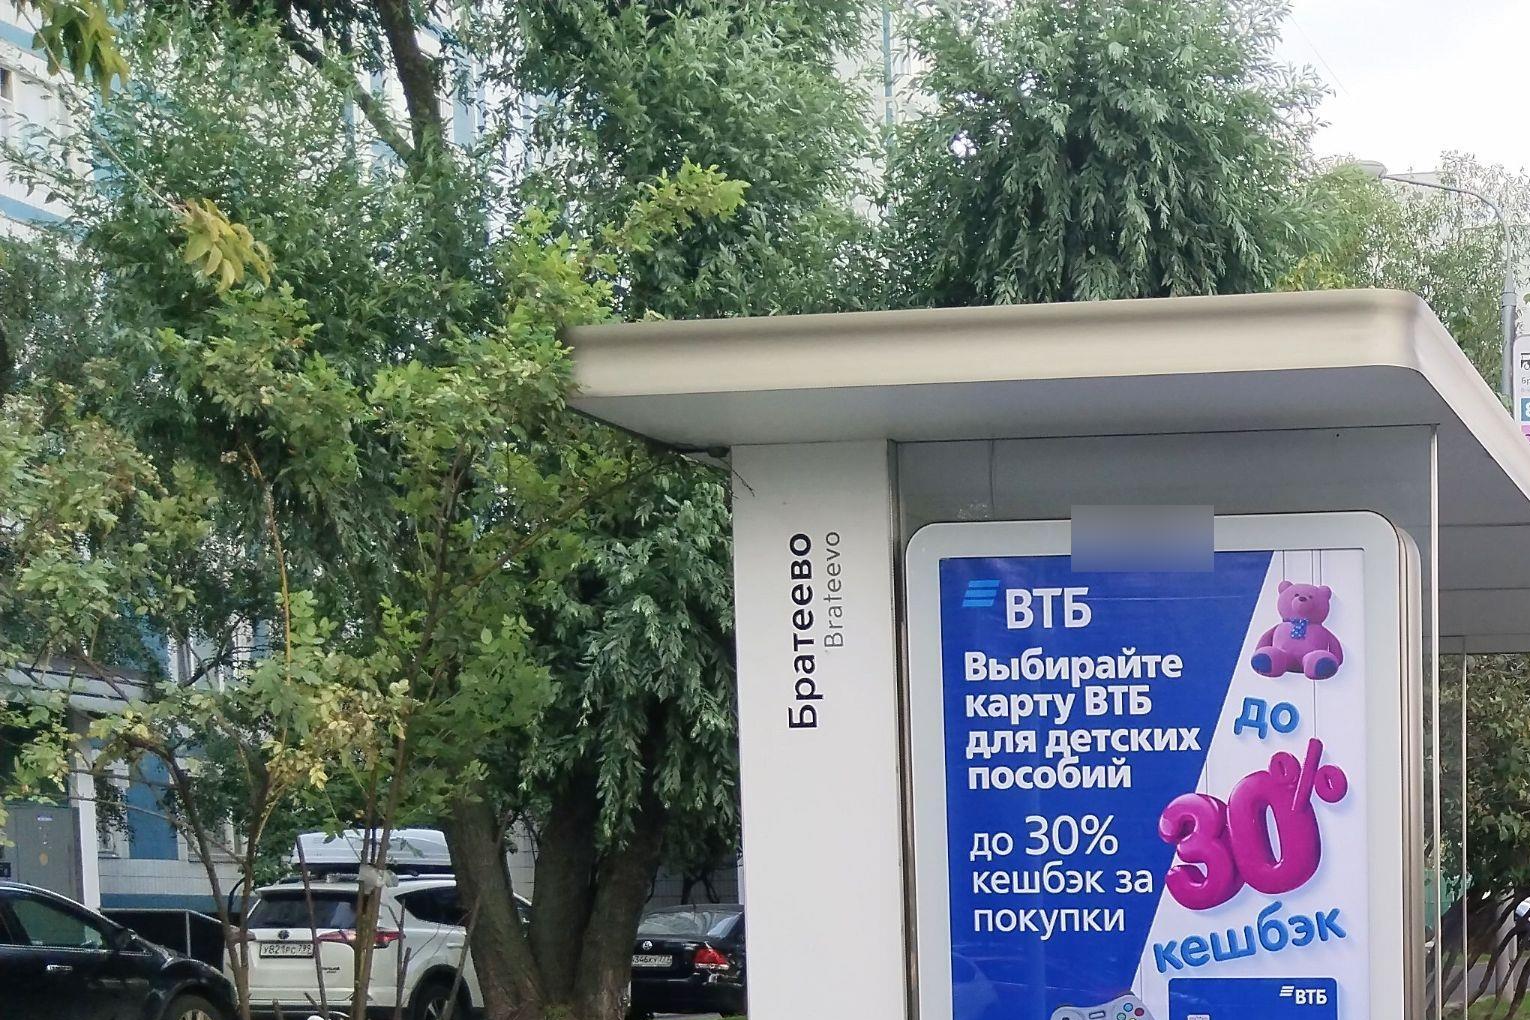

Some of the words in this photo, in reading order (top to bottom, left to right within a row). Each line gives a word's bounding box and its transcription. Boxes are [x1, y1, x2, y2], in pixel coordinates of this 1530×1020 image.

[823, 531, 844, 648] Brateevo
[1005, 586, 1092, 629] ВТБ
[788, 532, 824, 729] Братеево
[964, 646, 1183, 688] Выбирайте
[965, 692, 1076, 725] карту
[1085, 684, 1153, 716] ВТБ
[1233, 696, 1300, 740] до
[965, 730, 1037, 760] для
[1045, 726, 1202, 759] детских
[968, 755, 1132, 790] пособий
[969, 832, 1014, 861] до
[1025, 814, 1119, 856] 30%
[1158, 737, 1349, 911] 30%
[972, 860, 1106, 894] кешбэк
[1115, 869, 1154, 893] за
[974, 907, 1126, 941] покупки
[1153, 900, 1347, 974] кешбэк
[1295, 988, 1328, 1005] ВТБ
